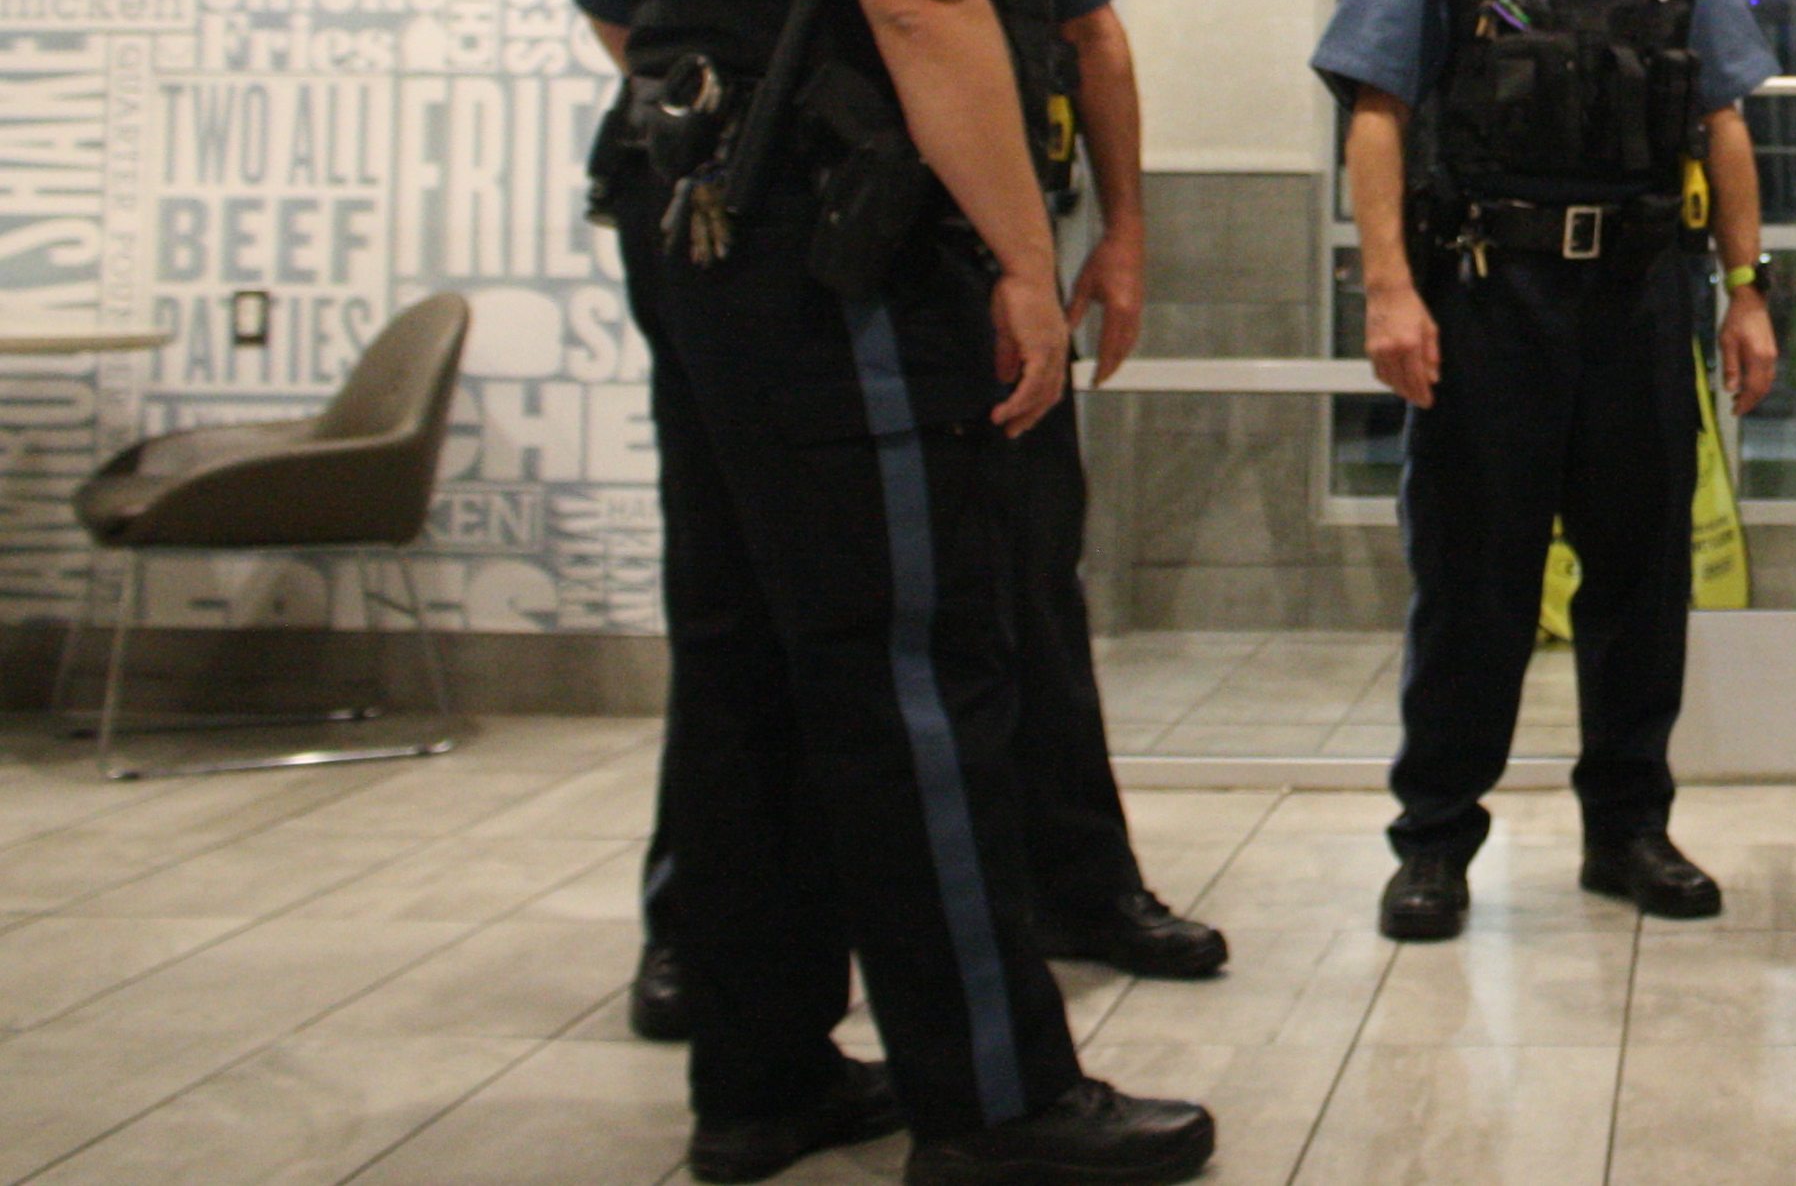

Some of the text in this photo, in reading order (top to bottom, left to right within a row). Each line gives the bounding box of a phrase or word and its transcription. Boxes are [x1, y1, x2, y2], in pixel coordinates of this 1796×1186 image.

[203, 12, 396, 72] Fries
[159, 81, 379, 185] TWO ALL
[155, 196, 375, 284] BEEF
